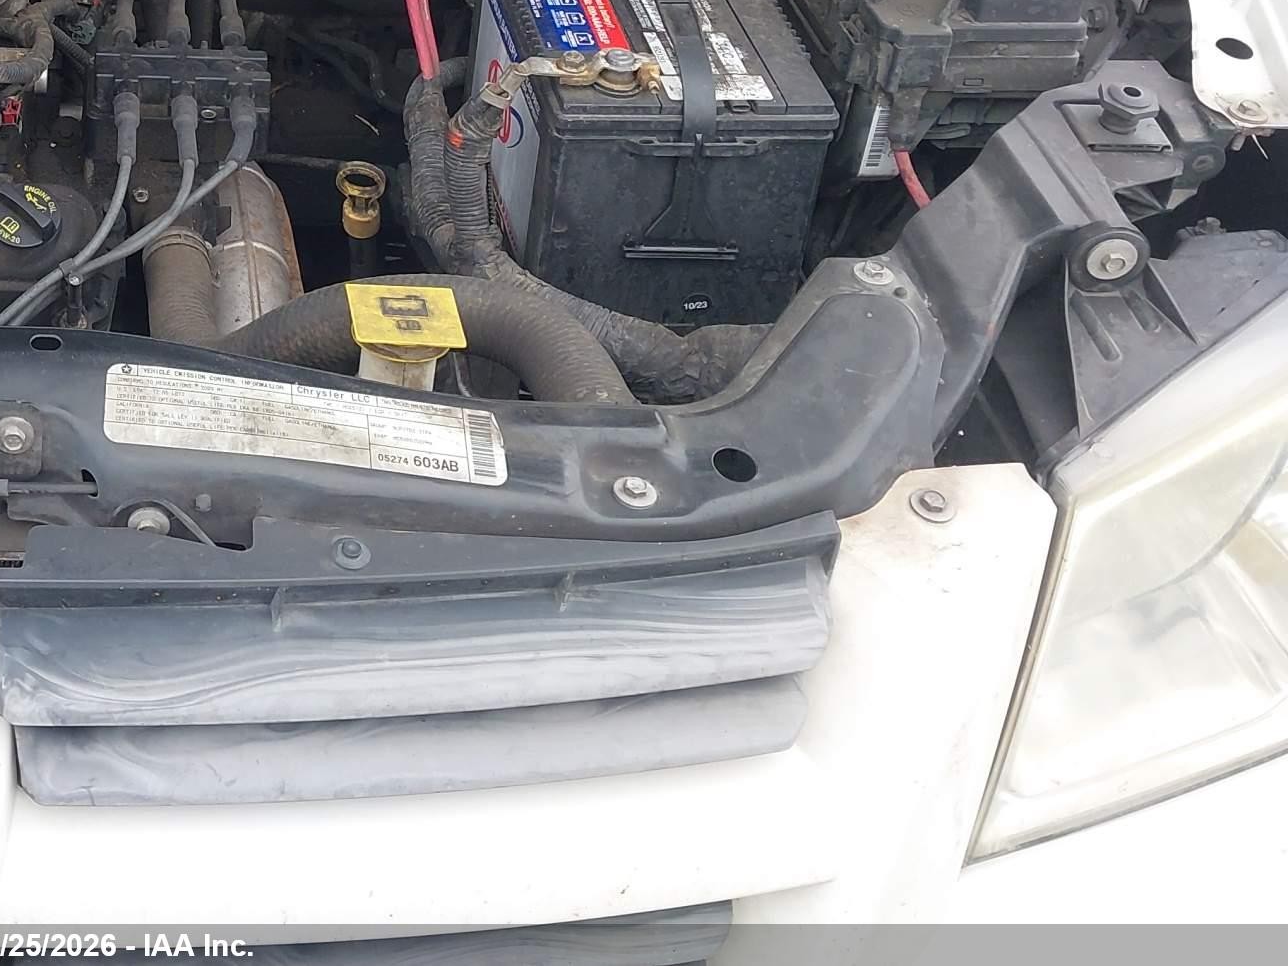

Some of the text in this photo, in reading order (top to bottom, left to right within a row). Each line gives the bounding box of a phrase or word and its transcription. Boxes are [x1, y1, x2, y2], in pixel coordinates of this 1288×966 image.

[24, 185, 57, 213] ENGINE OIL
[683, 301, 708, 310] 10/23
[144, 368, 284, 390] VEHICLE EMISSION CONTROL INFORMATION
[296, 385, 371, 404] Chrysler LLC
[377, 453, 459, 472] 05274 603AB
